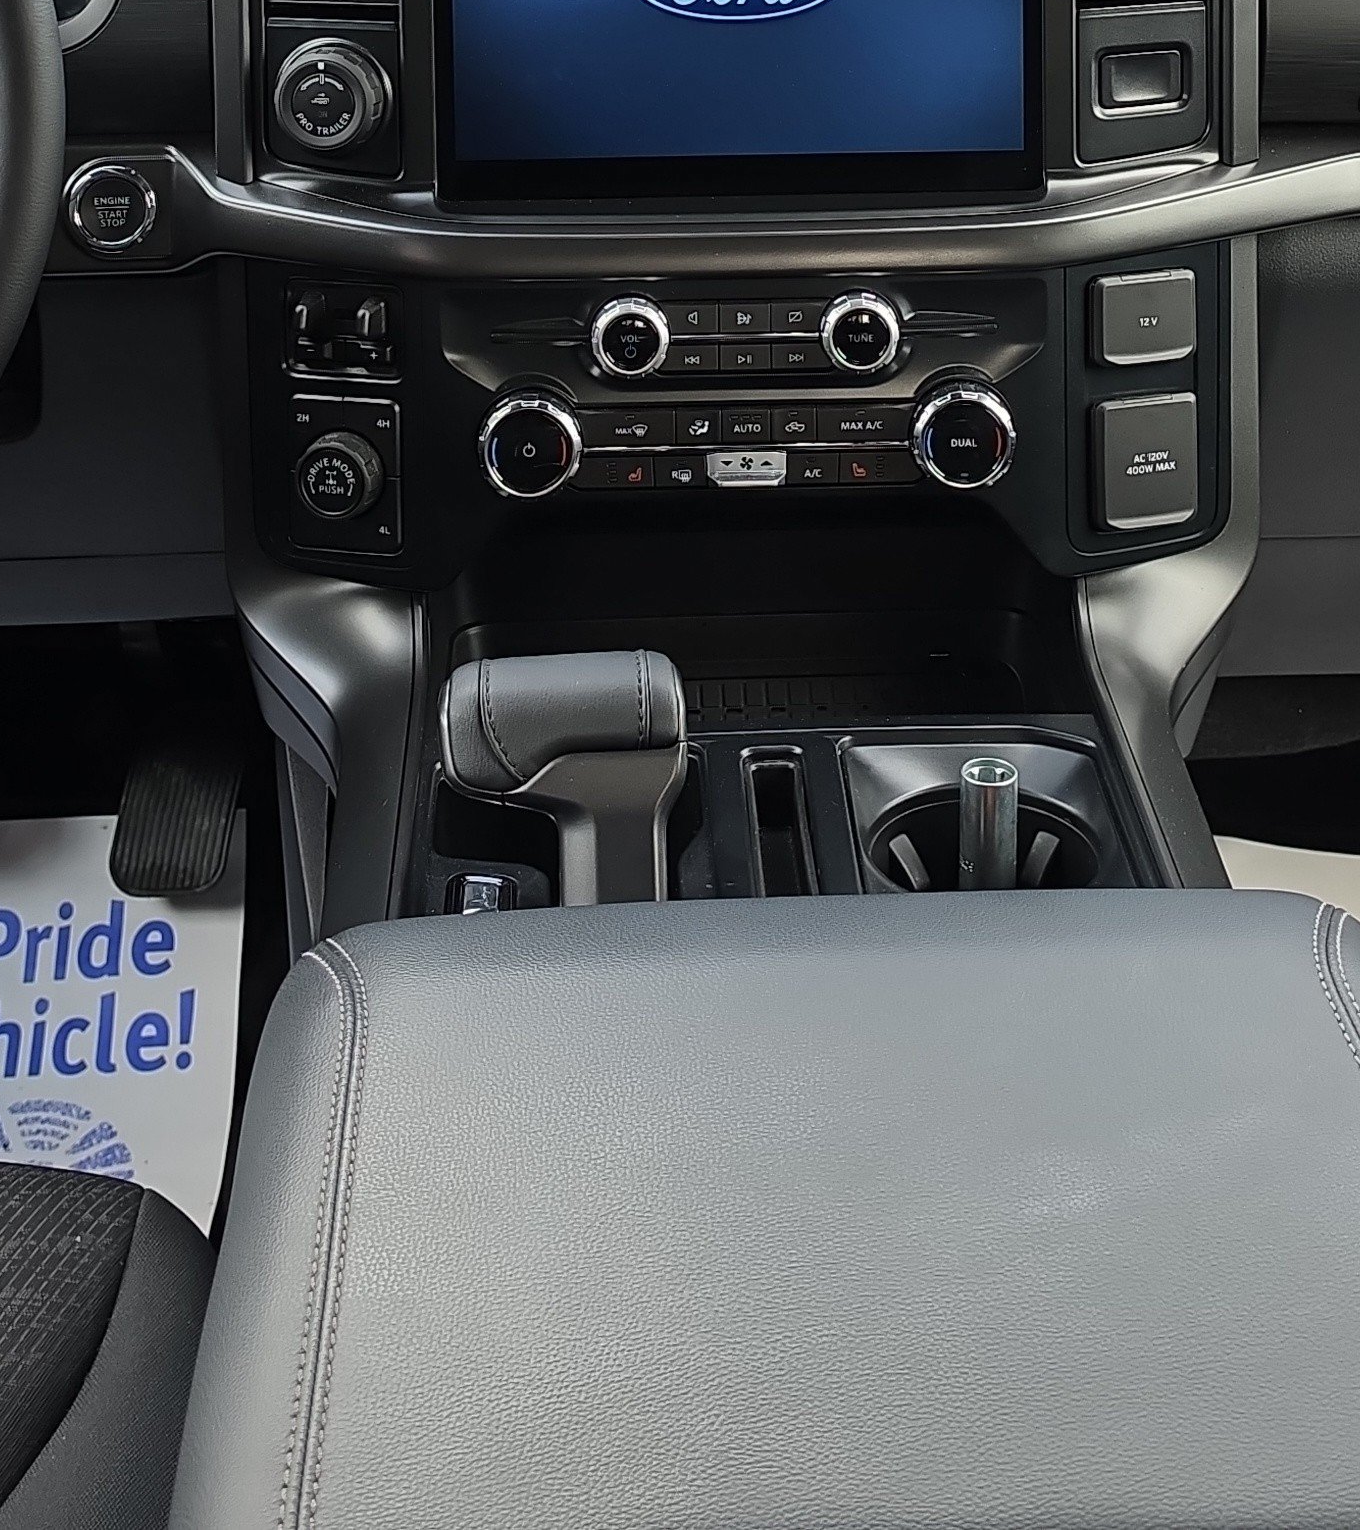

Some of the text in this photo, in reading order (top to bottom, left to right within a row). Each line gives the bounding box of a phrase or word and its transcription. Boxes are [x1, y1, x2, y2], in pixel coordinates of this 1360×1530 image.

[295, 112, 351, 135] PRO TRAILER
[94, 196, 131, 206] ENGINE
[97, 210, 128, 220] START
[100, 218, 126, 228] STOP
[1139, 316, 1159, 328] 12 V
[620, 334, 640, 343] VOL
[848, 333, 874, 343] TUNE
[296, 413, 310, 423] 2H
[376, 419, 390, 429] 4H
[733, 423, 761, 433] AUTO
[840, 420, 884, 431] MAX A/C
[615, 427, 633, 435] MAX
[950, 437, 977, 448] DUAL
[1133, 450, 1169, 464] AC 120V
[307, 457, 356, 485] DRIVE MODE
[804, 468, 823, 478] A/C
[1126, 460, 1177, 476] 400W MAX
[319, 484, 344, 495] PUSH
[378, 525, 390, 535] 4L
